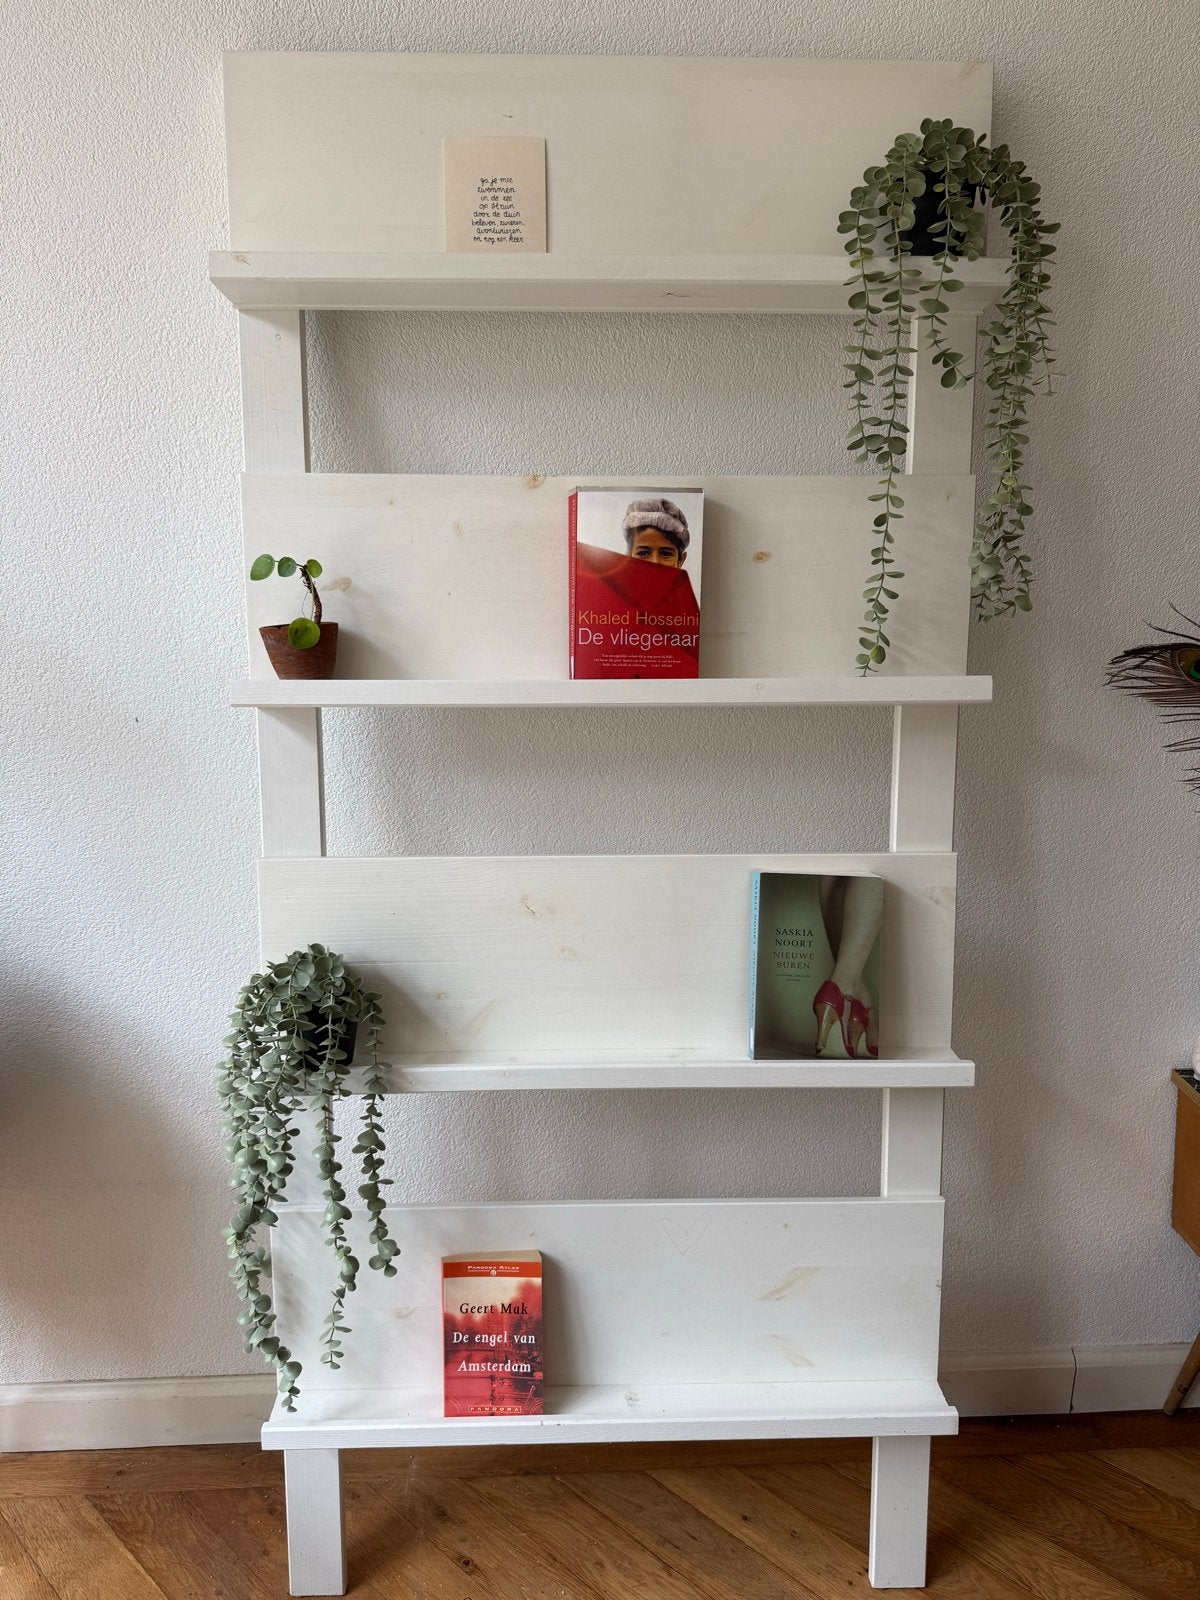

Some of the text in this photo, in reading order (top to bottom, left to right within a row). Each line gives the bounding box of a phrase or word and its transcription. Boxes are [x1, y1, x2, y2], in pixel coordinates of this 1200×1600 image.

[480, 177, 489, 186] ga
[490, 176, 498, 186] je
[484, 236, 495, 245] nog
[509, 234, 524, 243] keer
[578, 610, 699, 626] Khaled Hosseini
[578, 627, 700, 651] De vliegeraar
[775, 927, 814, 937] SASKIA
[775, 939, 814, 948] NOORT
[773, 951, 815, 960] NIEUWE
[776, 961, 811, 969] BUREN
[459, 1302, 528, 1315] Geert Mak
[452, 1330, 536, 1347] De engel van
[457, 1360, 532, 1373] Amsterdam
